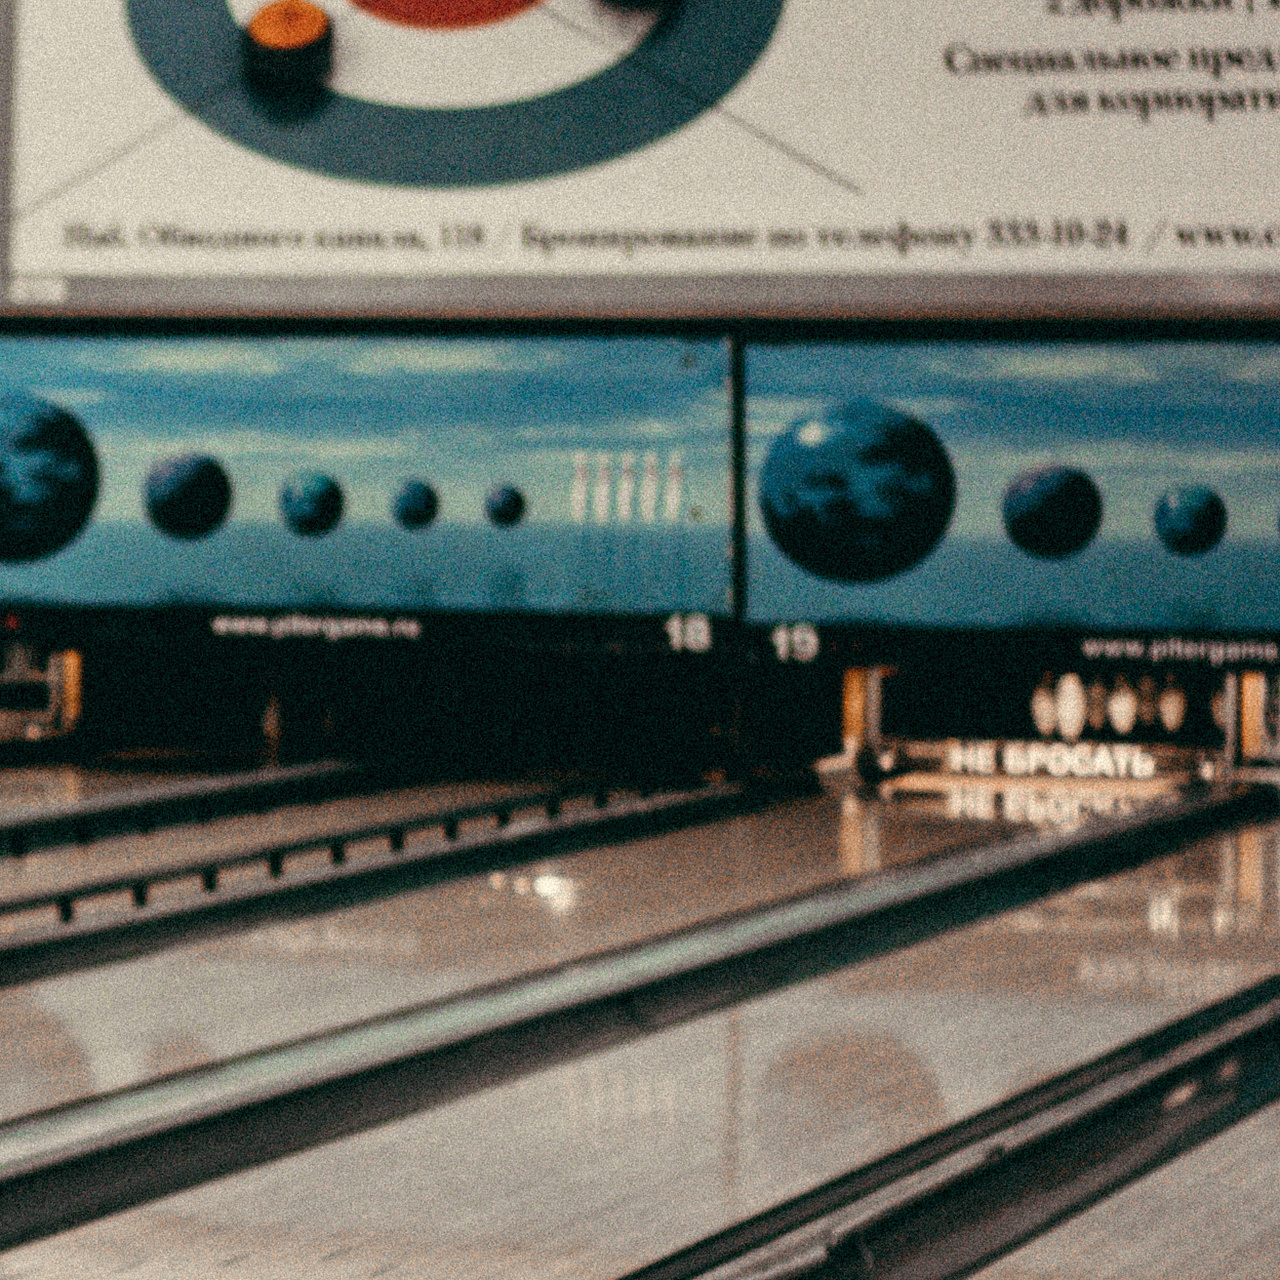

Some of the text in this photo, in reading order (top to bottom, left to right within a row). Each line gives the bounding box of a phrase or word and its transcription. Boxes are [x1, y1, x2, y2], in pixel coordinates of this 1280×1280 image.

[942, 40, 1180, 76] Специальное
[1025, 89, 1090, 118] для
[666, 613, 712, 652] 18
[772, 623, 819, 662] 19
